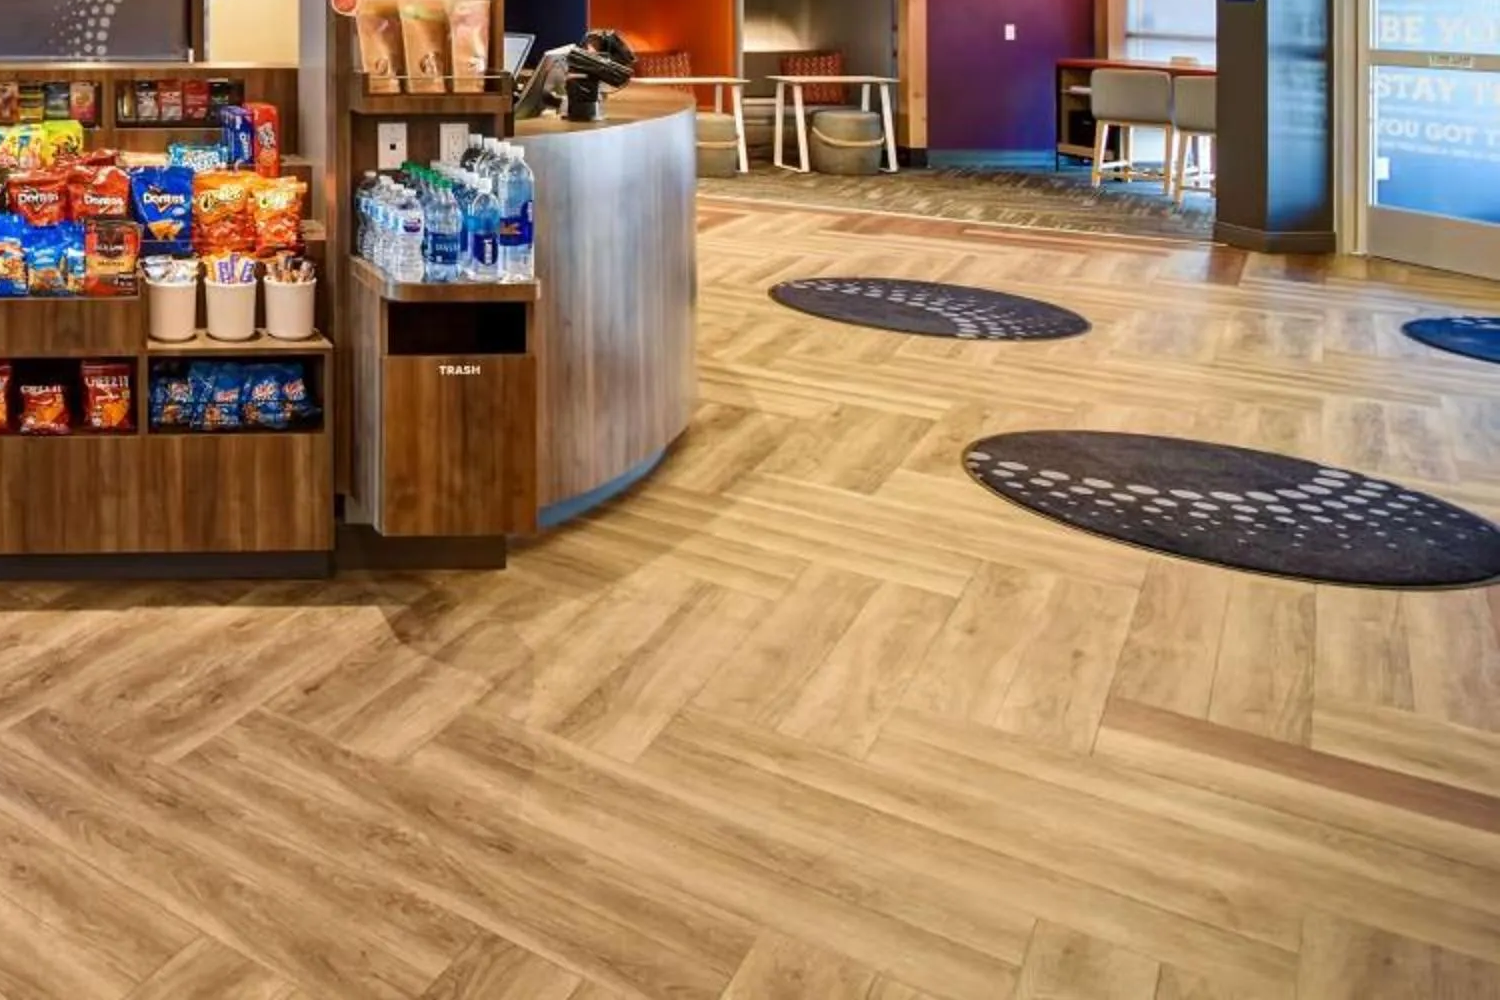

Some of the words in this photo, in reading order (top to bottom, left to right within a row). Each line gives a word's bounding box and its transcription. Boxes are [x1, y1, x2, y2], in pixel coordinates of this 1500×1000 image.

[1435, 16, 1500, 47] YO
[143, 192, 185, 206] Doritos
[438, 364, 481, 376] TRASH
